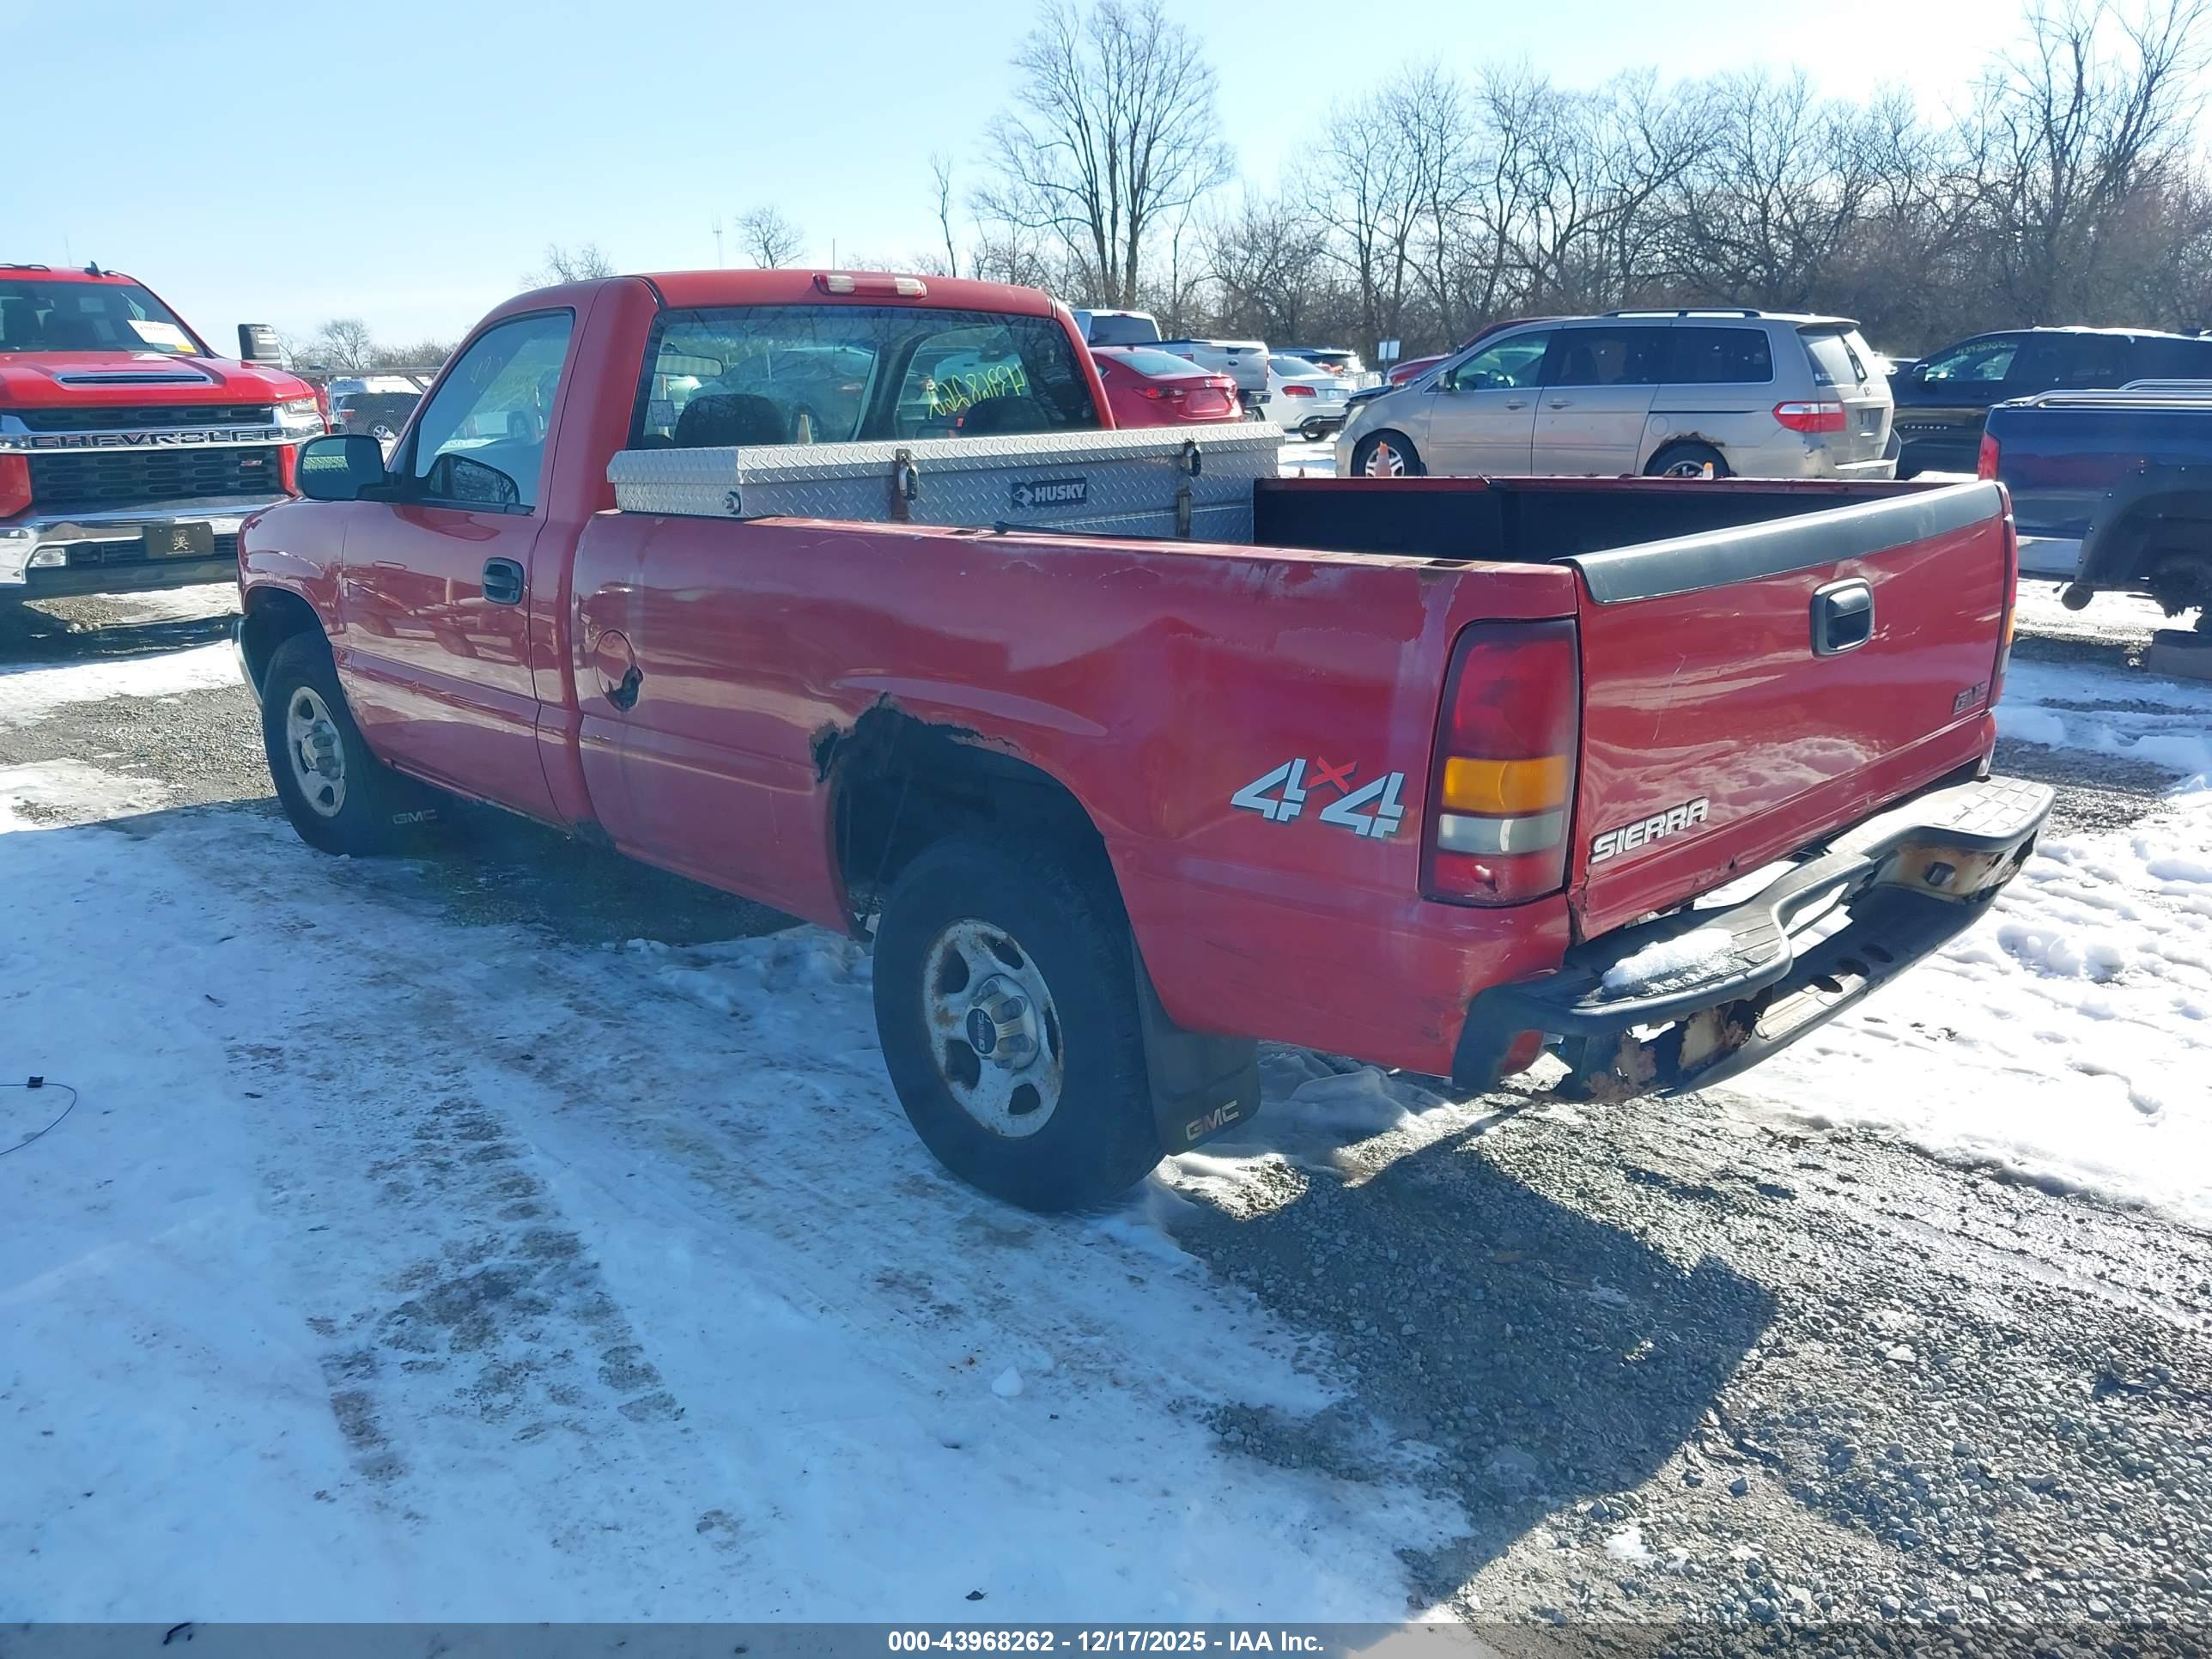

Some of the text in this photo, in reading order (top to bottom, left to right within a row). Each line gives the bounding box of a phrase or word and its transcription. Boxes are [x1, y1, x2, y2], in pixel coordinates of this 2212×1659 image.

[29, 428, 285, 448] CHEVROLET
[1035, 483, 1085, 502] HUSKY
[1953, 680, 1988, 715] GMC
[392, 809, 438, 824] GMC
[1590, 797, 1710, 864] SIERRA
[1186, 1099, 1240, 1141] GMC
